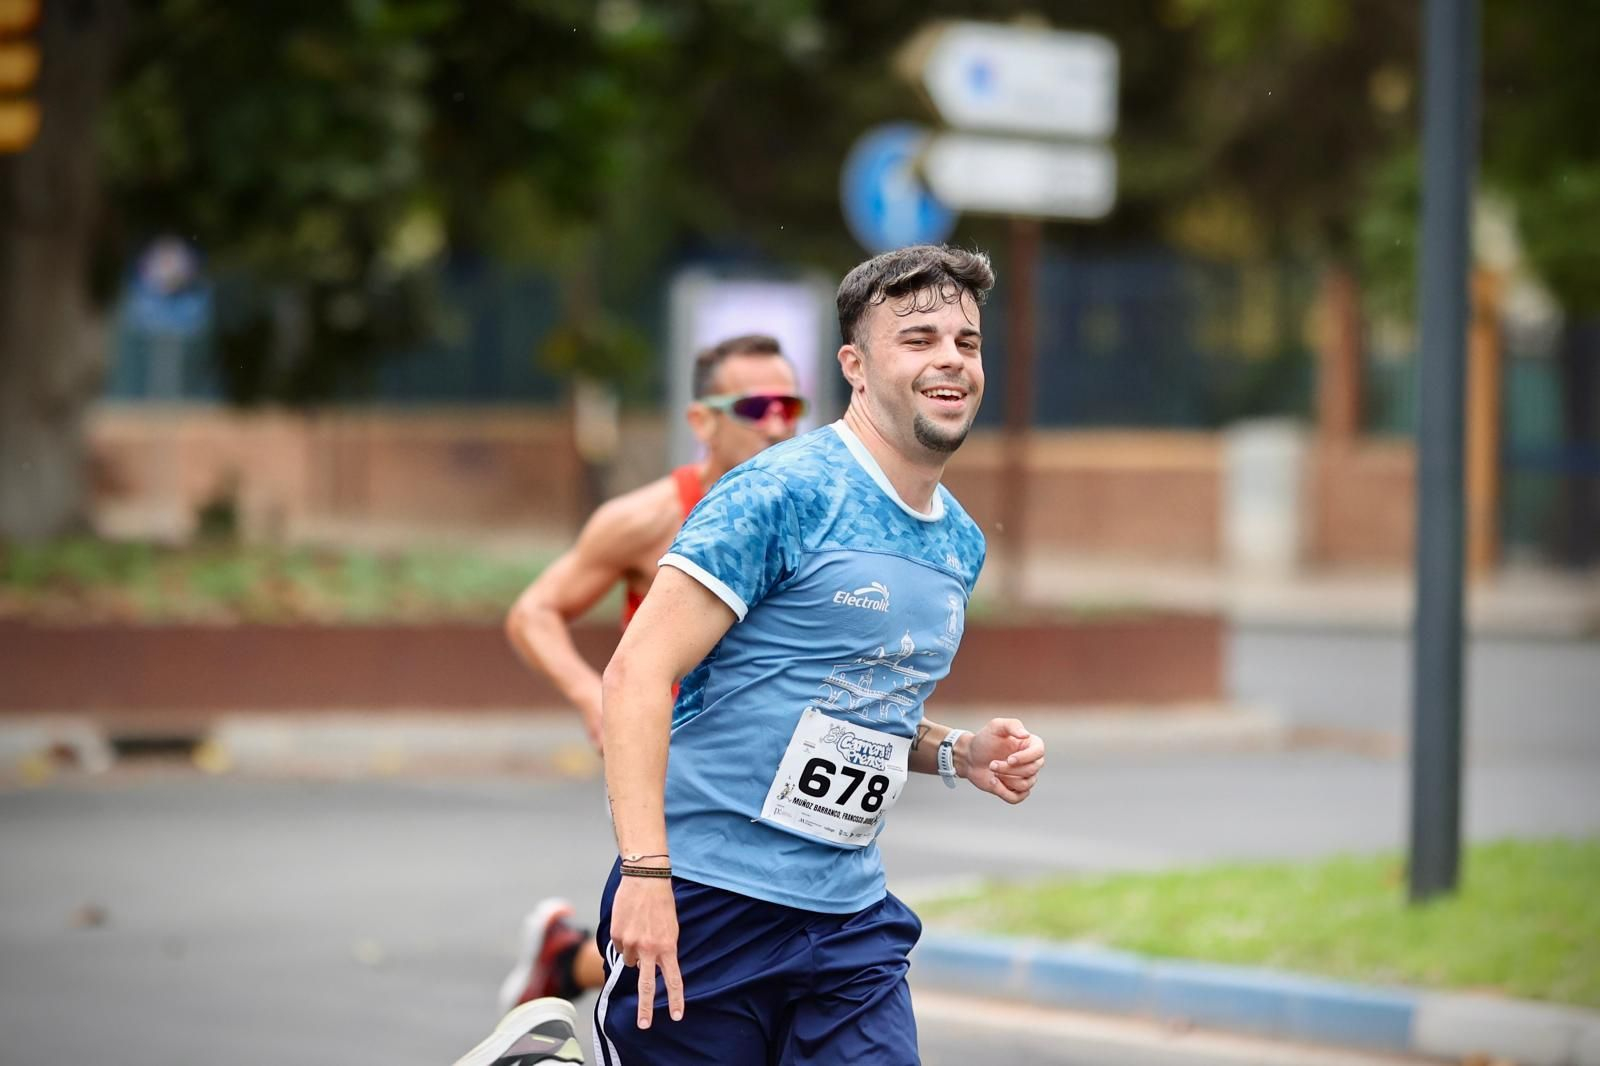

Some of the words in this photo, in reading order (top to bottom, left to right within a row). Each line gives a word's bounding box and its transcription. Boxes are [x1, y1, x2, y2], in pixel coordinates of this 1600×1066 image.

[833, 590, 889, 613] Electrolit
[798, 757, 890, 813] 678
[792, 797, 814, 811] MUÑOZ
[813, 804, 842, 820] BARRANCO,
[841, 812, 864, 824] FRANCISCO
